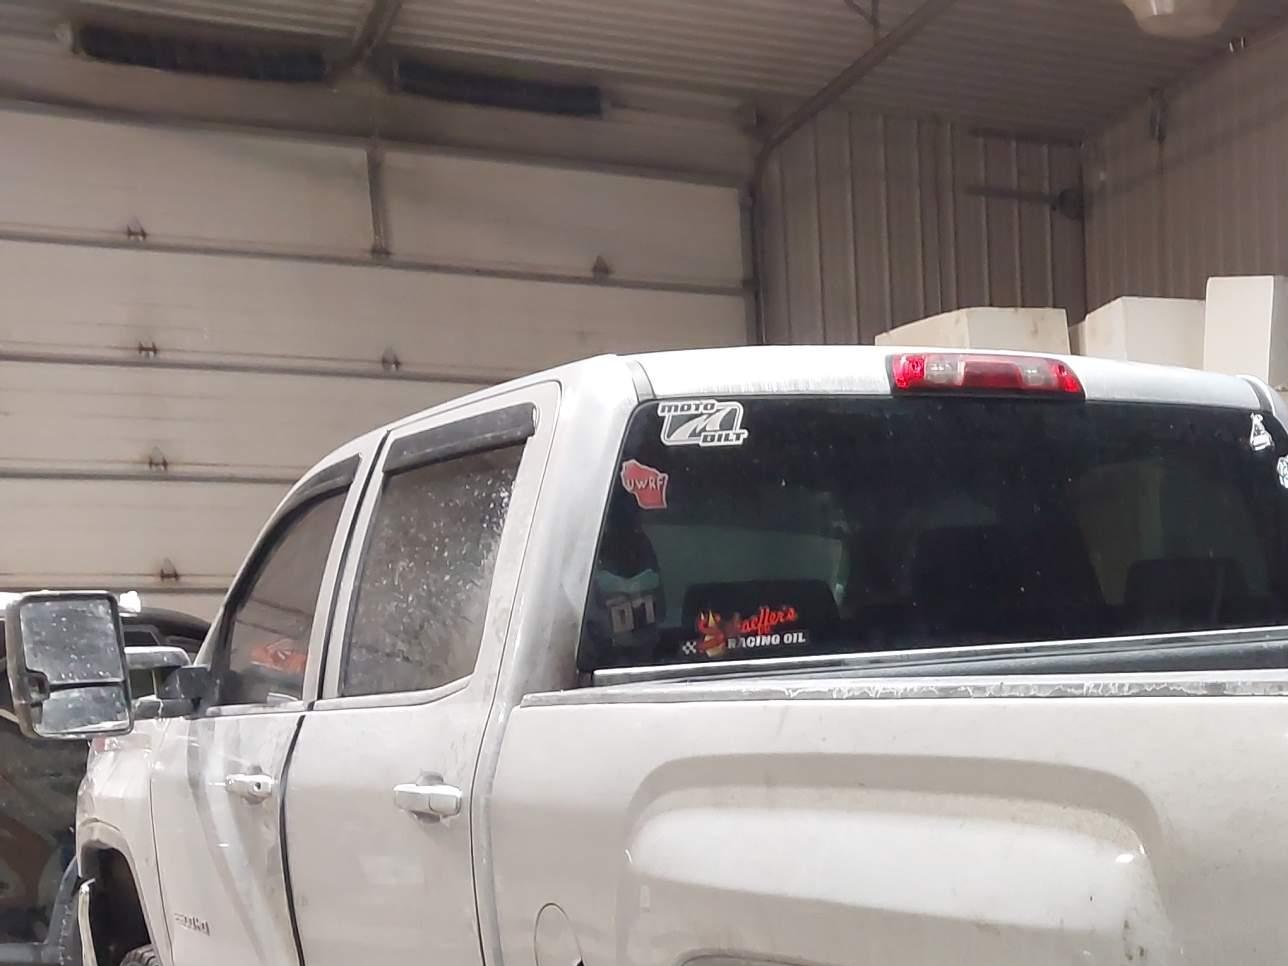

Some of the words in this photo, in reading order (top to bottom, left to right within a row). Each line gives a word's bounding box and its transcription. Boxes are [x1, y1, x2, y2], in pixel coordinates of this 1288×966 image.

[659, 401, 717, 415] MOTO
[626, 476, 664, 491] UWRF
[727, 633, 780, 650] RACING
[783, 631, 807, 644] OIL
